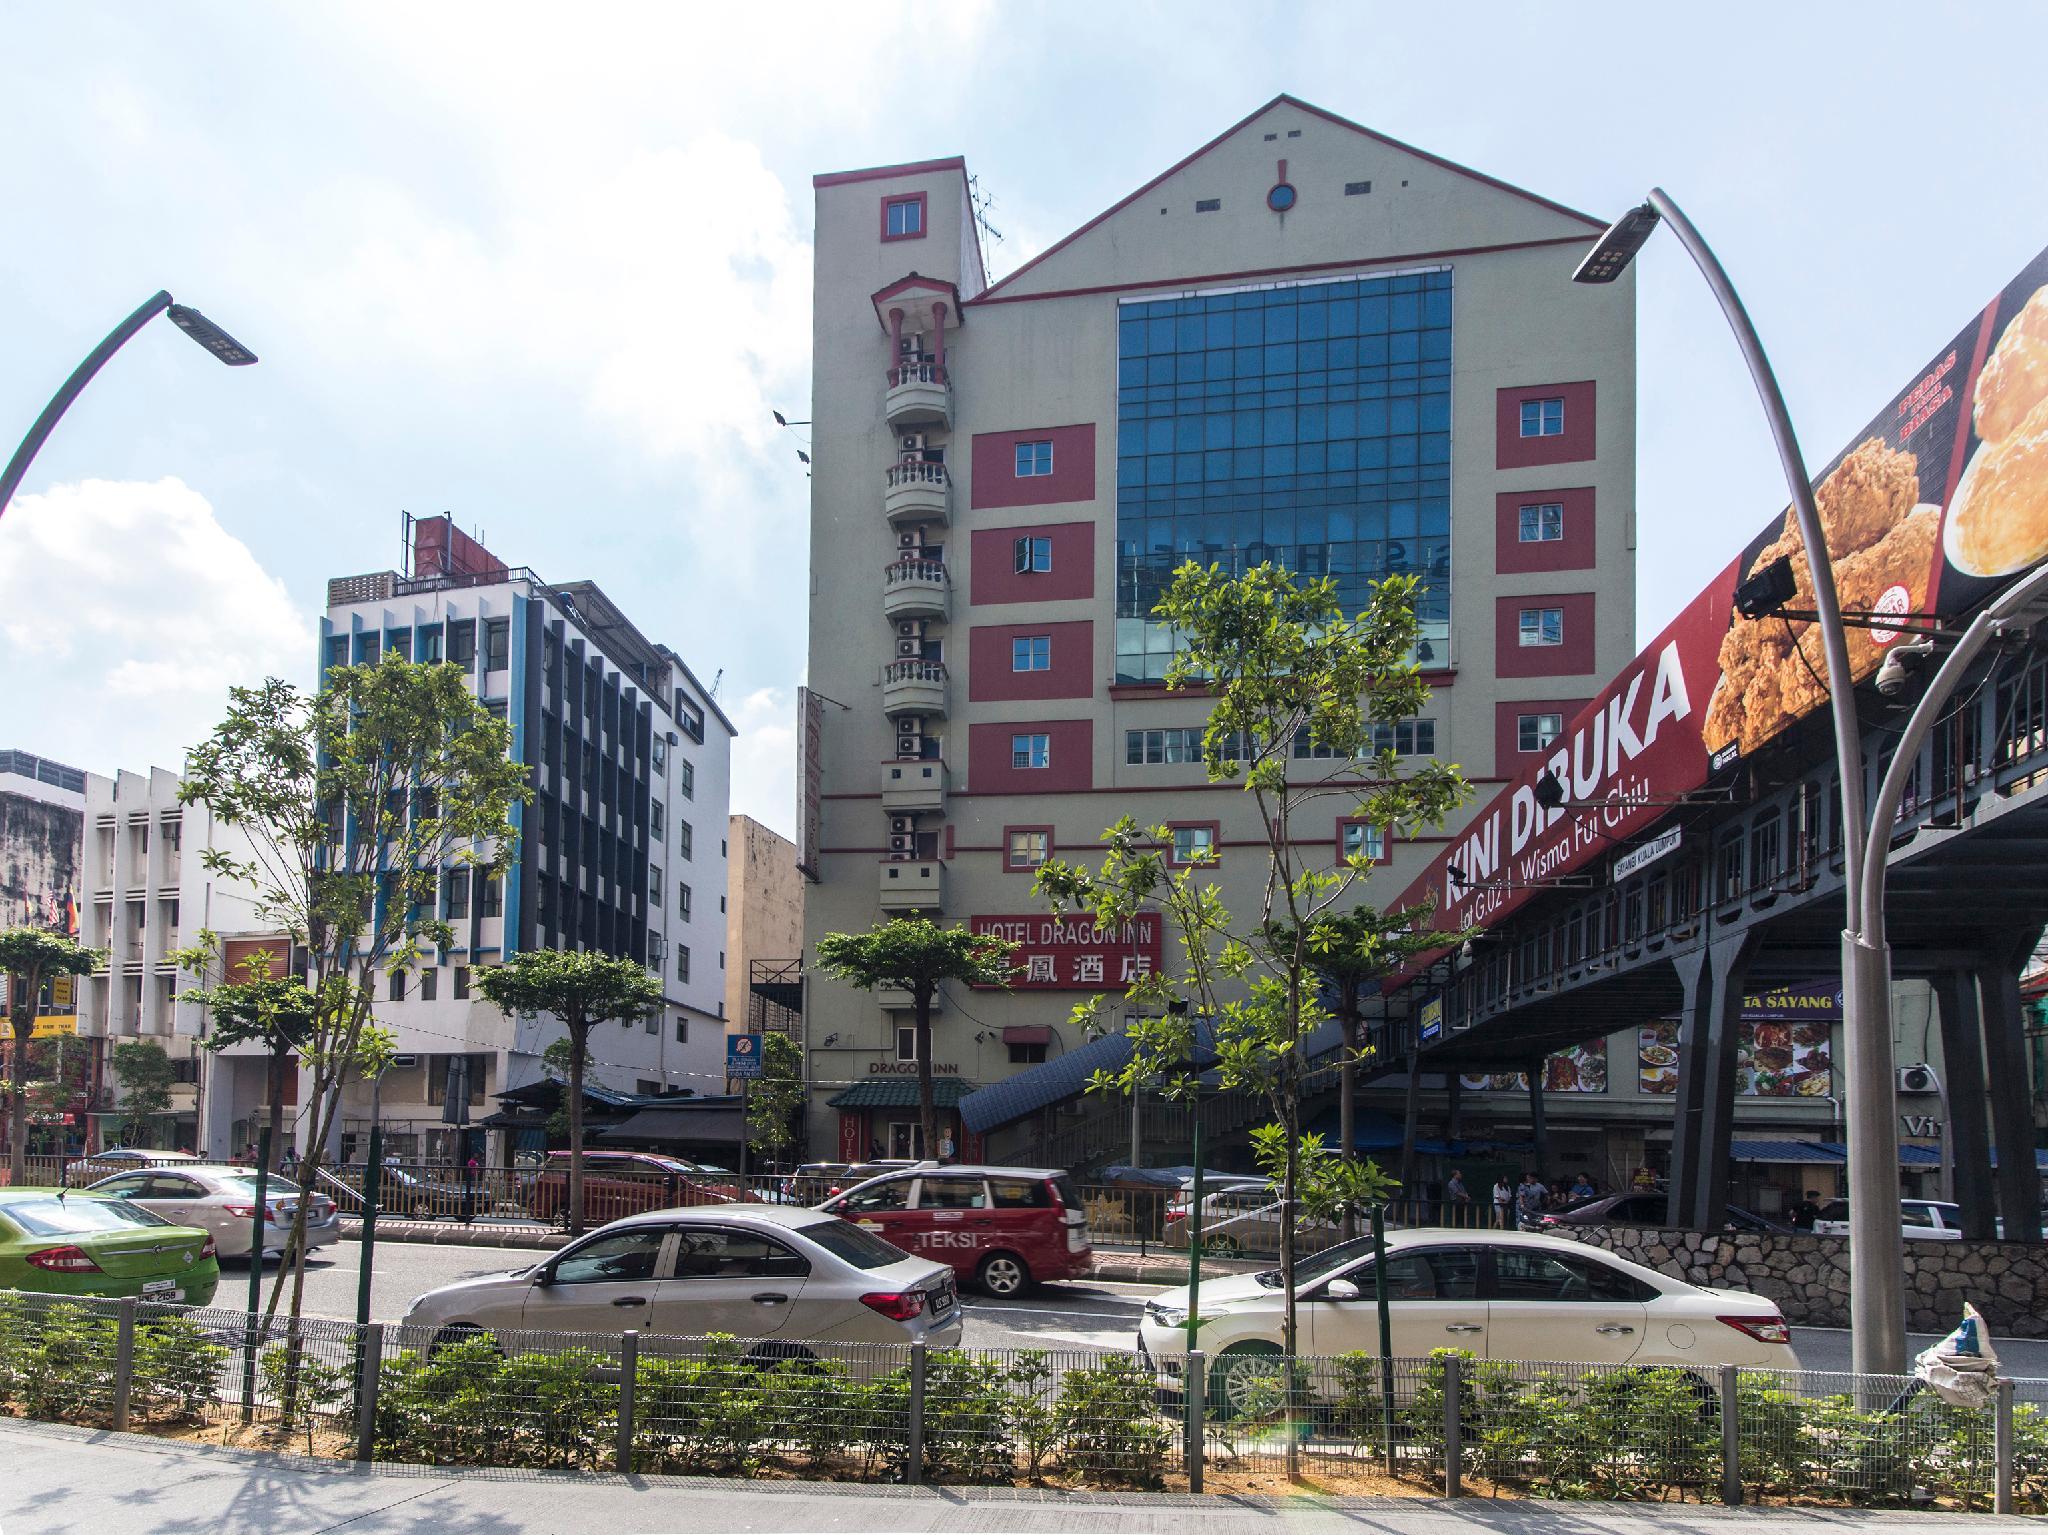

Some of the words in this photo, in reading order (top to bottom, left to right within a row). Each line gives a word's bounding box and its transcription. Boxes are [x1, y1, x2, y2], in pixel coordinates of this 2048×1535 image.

[1899, 384, 1953, 444] BIASA
[1445, 808, 1500, 911] KINI
[1511, 639, 1692, 857] DIBUKA
[1521, 836, 1570, 886] Wisma
[1575, 808, 1598, 852] Fui
[1603, 775, 1650, 828] Chiu
[1638, 846, 1655, 864] KUALA
[980, 922, 1035, 945] HOTEL
[1041, 921, 1116, 945] DRAGON
[1122, 921, 1151, 945] INN
[1766, 996, 1832, 1009] SAYANG
[869, 1063, 919, 1074] DRAGO
[933, 1063, 958, 1074] INN
[918, 1232, 977, 1248] TEKSI
